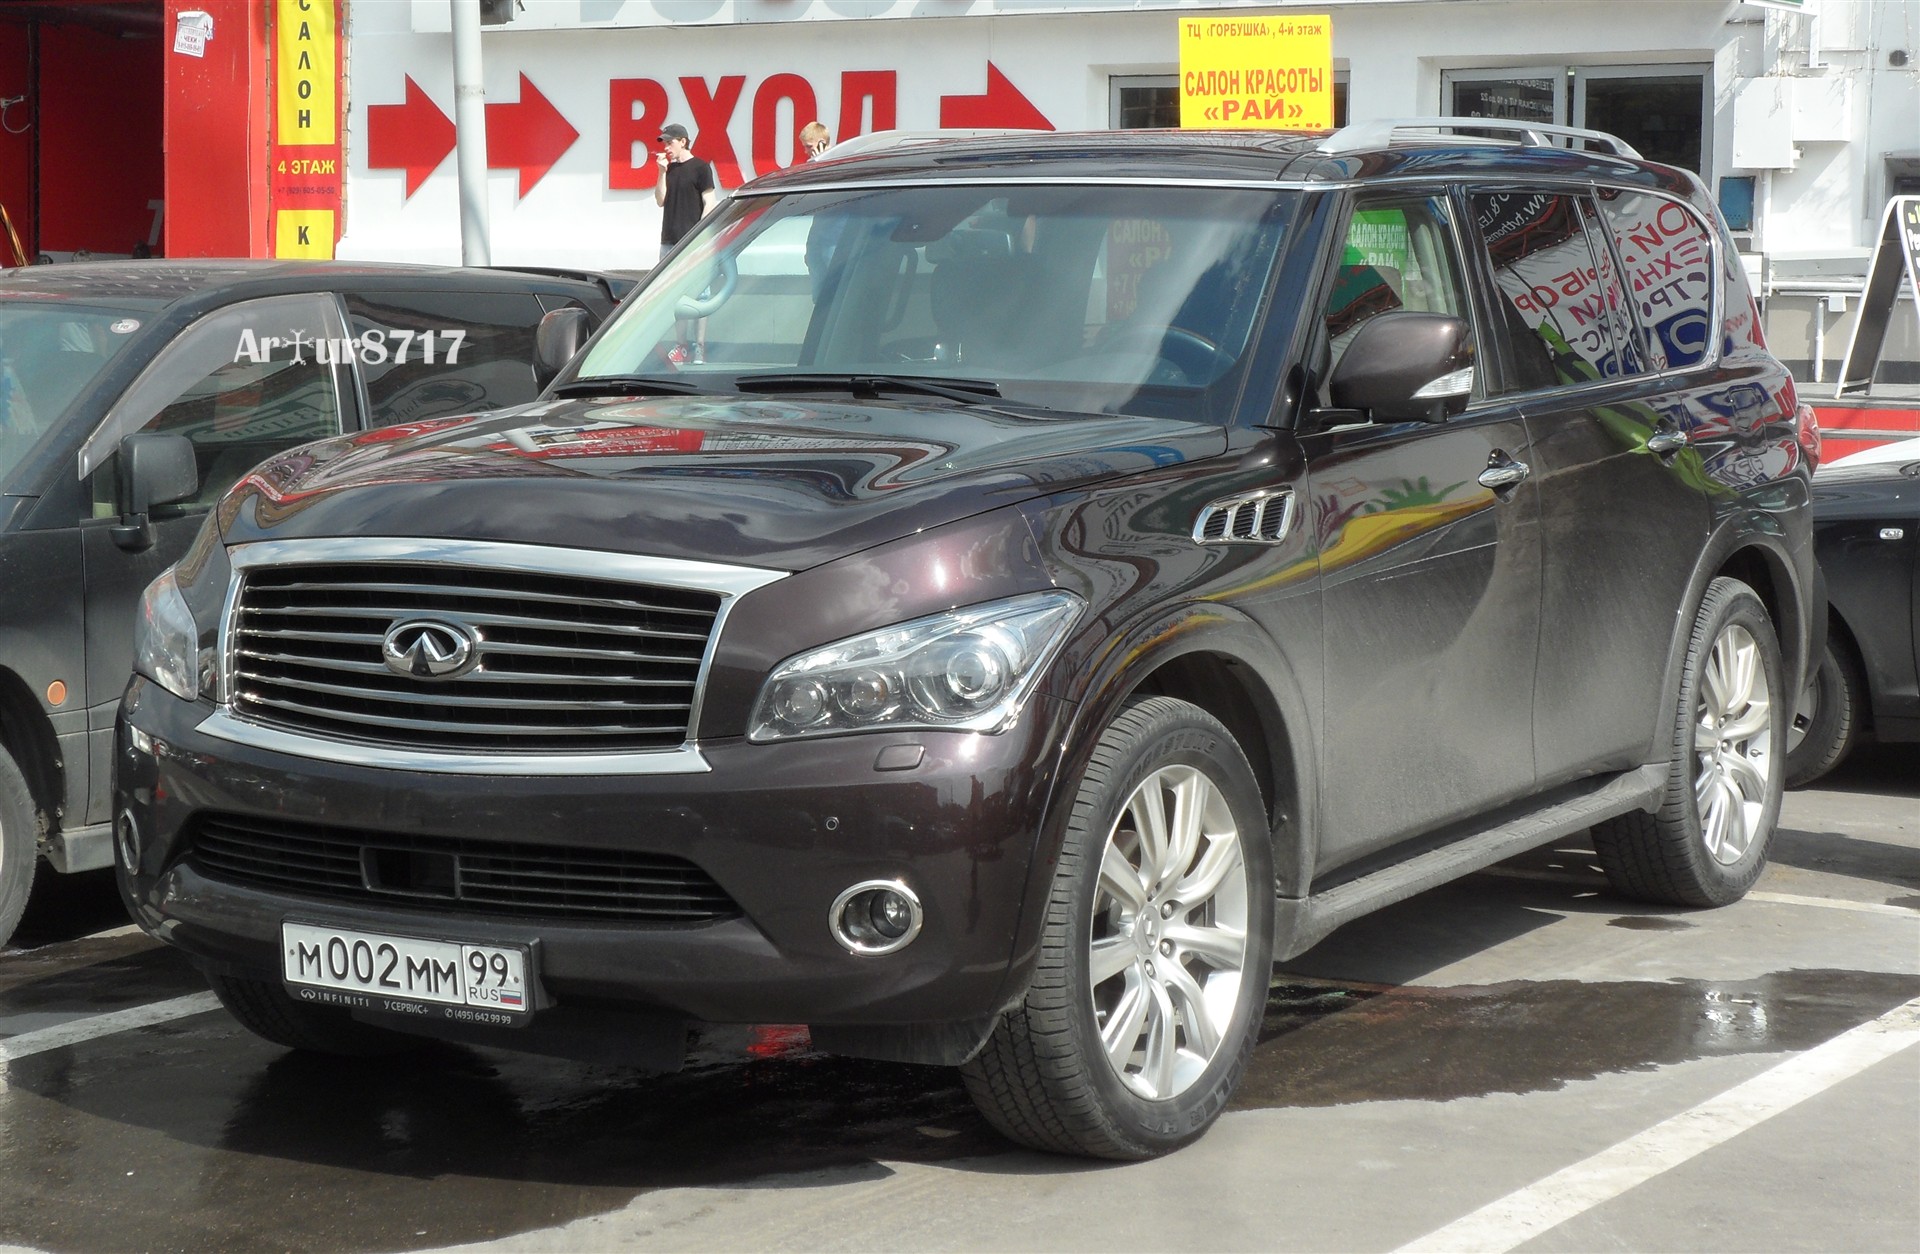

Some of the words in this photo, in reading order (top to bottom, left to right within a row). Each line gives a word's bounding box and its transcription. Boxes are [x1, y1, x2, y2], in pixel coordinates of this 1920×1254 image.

[1187, 24, 1201, 40] ТЦ
[1278, 22, 1294, 36] 4-й
[1297, 24, 1322, 36] этаж
[1185, 70, 1240, 97] САЛОН
[1245, 67, 1323, 95] КРАСОТЫ
[1204, 93, 1303, 121] «РАЙ»
[609, 70, 897, 190] ВХОД
[278, 160, 286, 174] 4
[291, 160, 335, 174] ЭТАЖ
[298, 226, 310, 245] К
[468, 950, 510, 987] 99
[318, 992, 369, 1007] INFINITI
[469, 986, 499, 1002] RUS
[454, 1010, 473, 1020] (495)
[474, 1012, 489, 1021] 642
[490, 1014, 500, 1022] 99
[501, 1015, 511, 1024] 99
